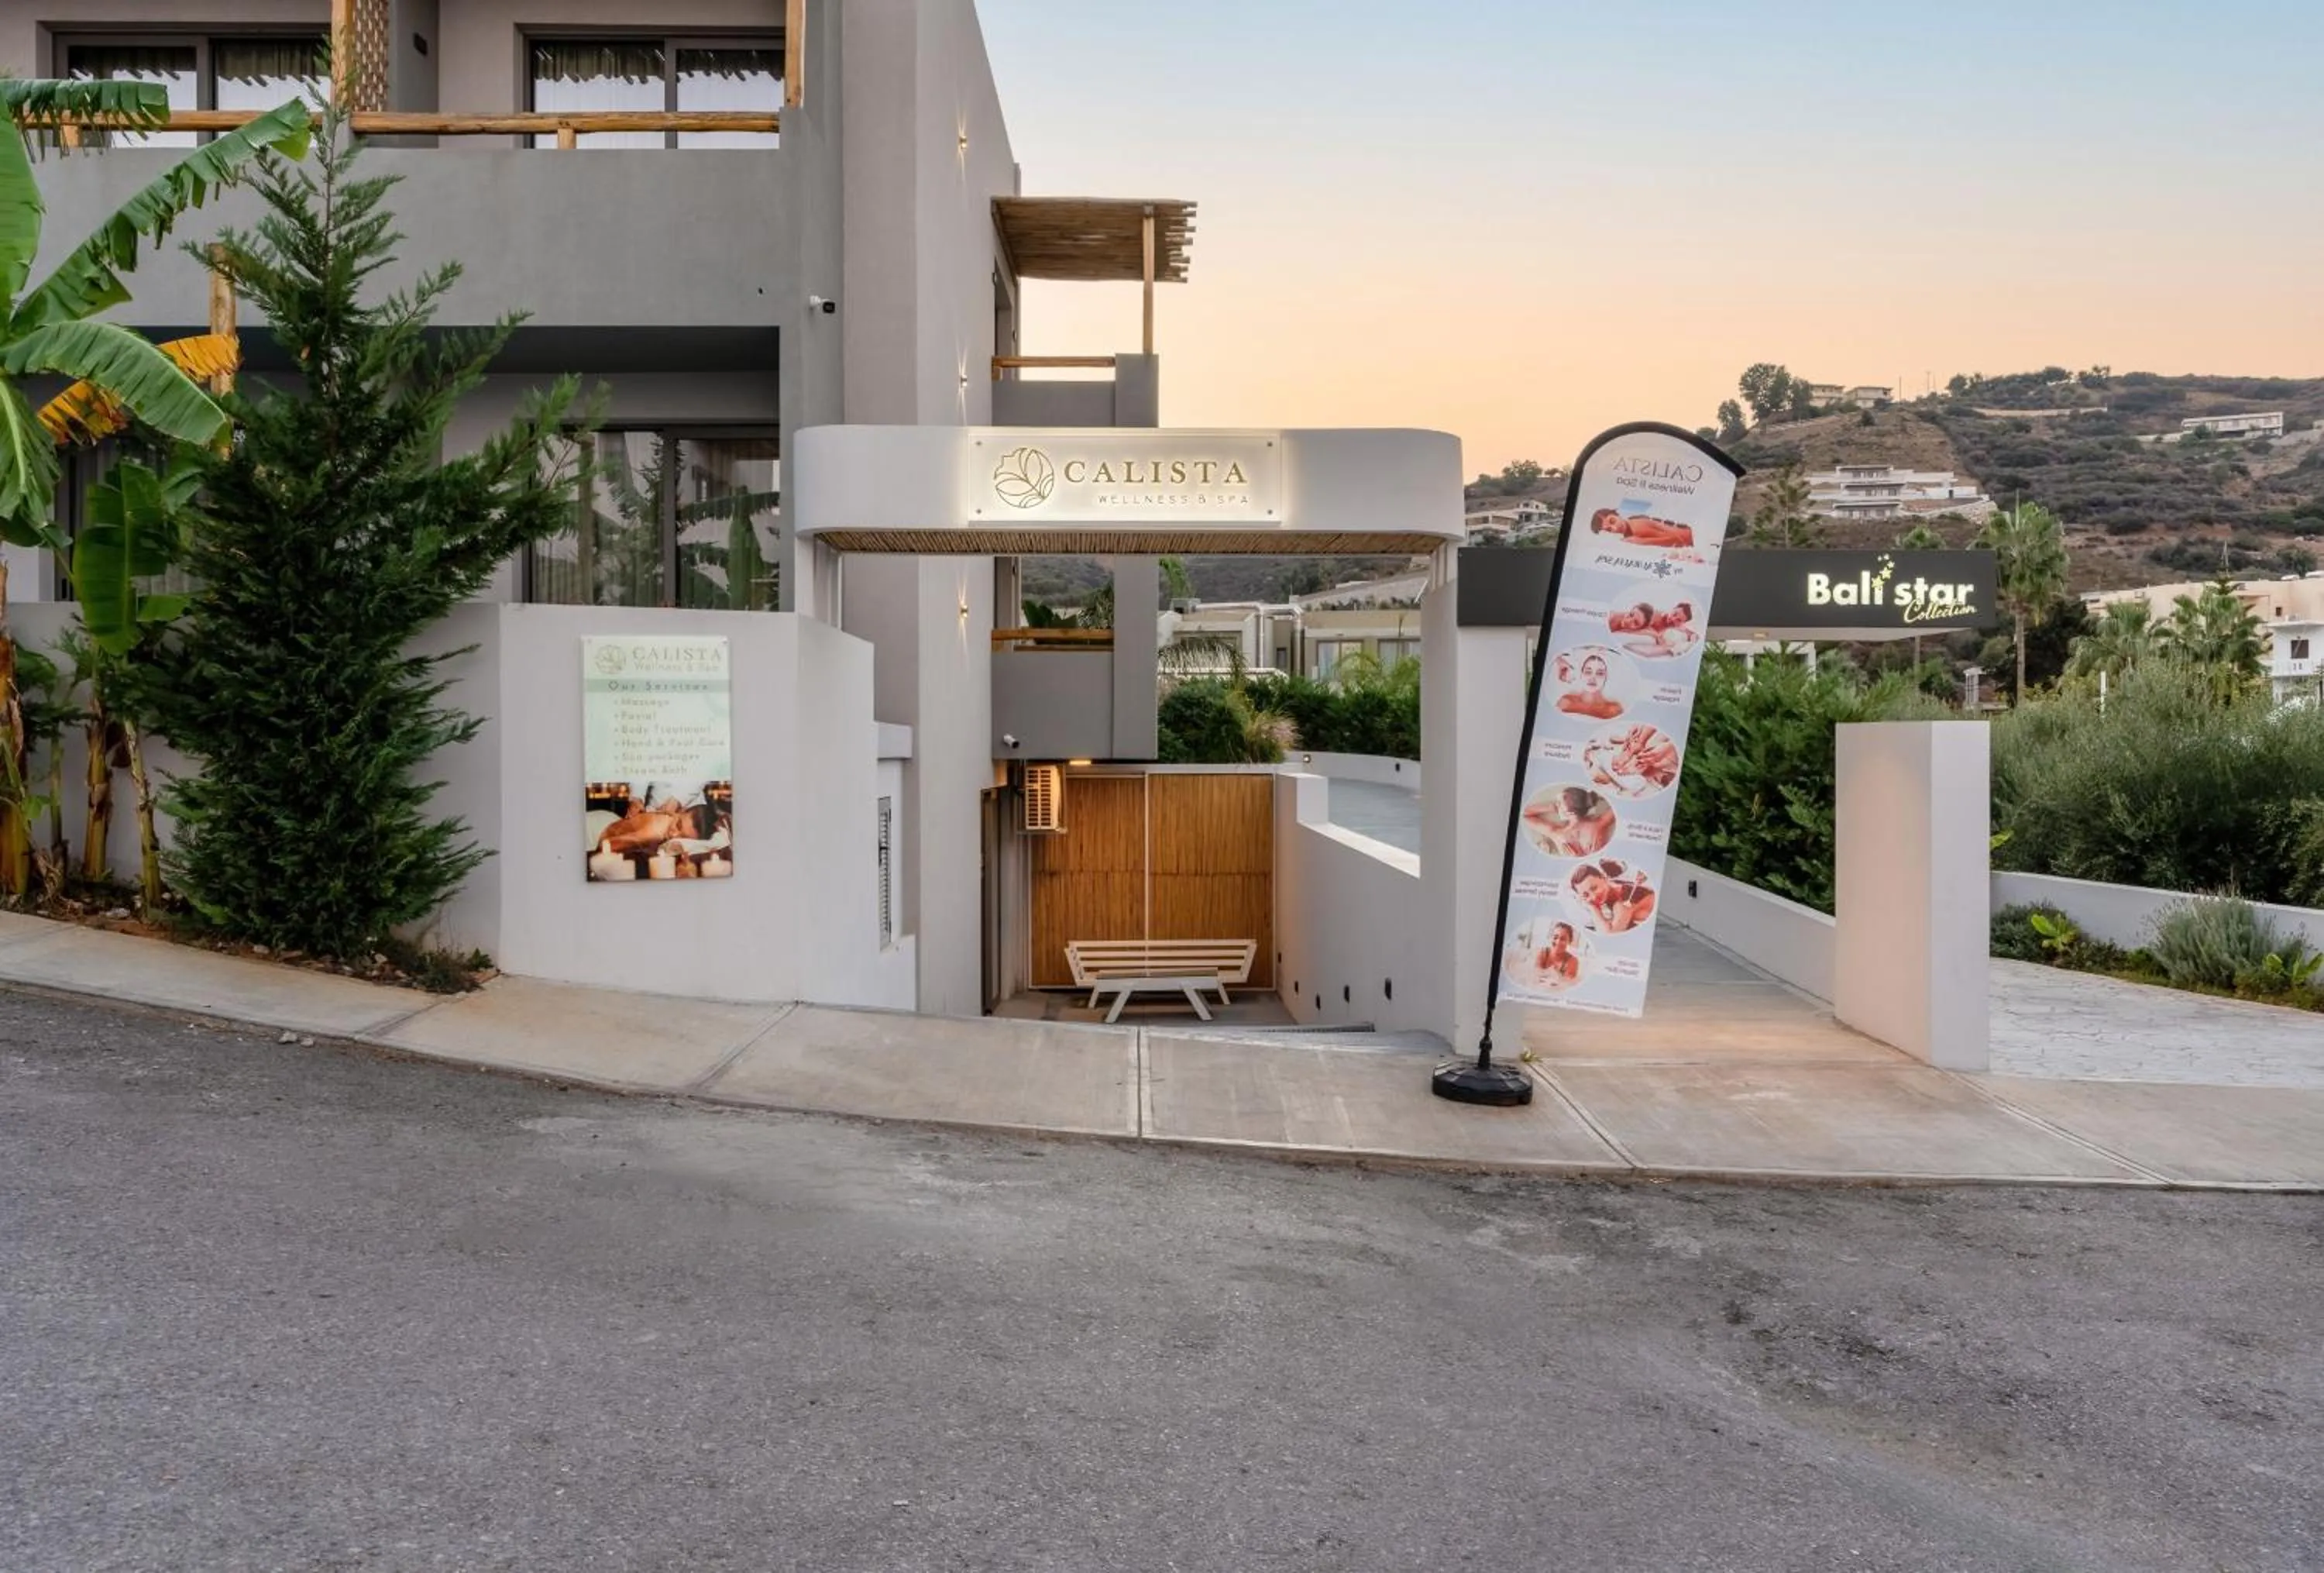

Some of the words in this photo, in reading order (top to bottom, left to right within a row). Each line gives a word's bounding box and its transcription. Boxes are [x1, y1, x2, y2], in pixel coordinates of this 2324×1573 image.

[1064, 460, 1248, 484] CALISTA
[1098, 495, 1188, 504] WELLNESS
[1218, 496, 1250, 504] SPA
[1807, 570, 1883, 605] Bali
[1893, 577, 1975, 605] star
[1903, 598, 1977, 623] Collection
[632, 646, 722, 661] CALISTA
[608, 680, 635, 691] Our
